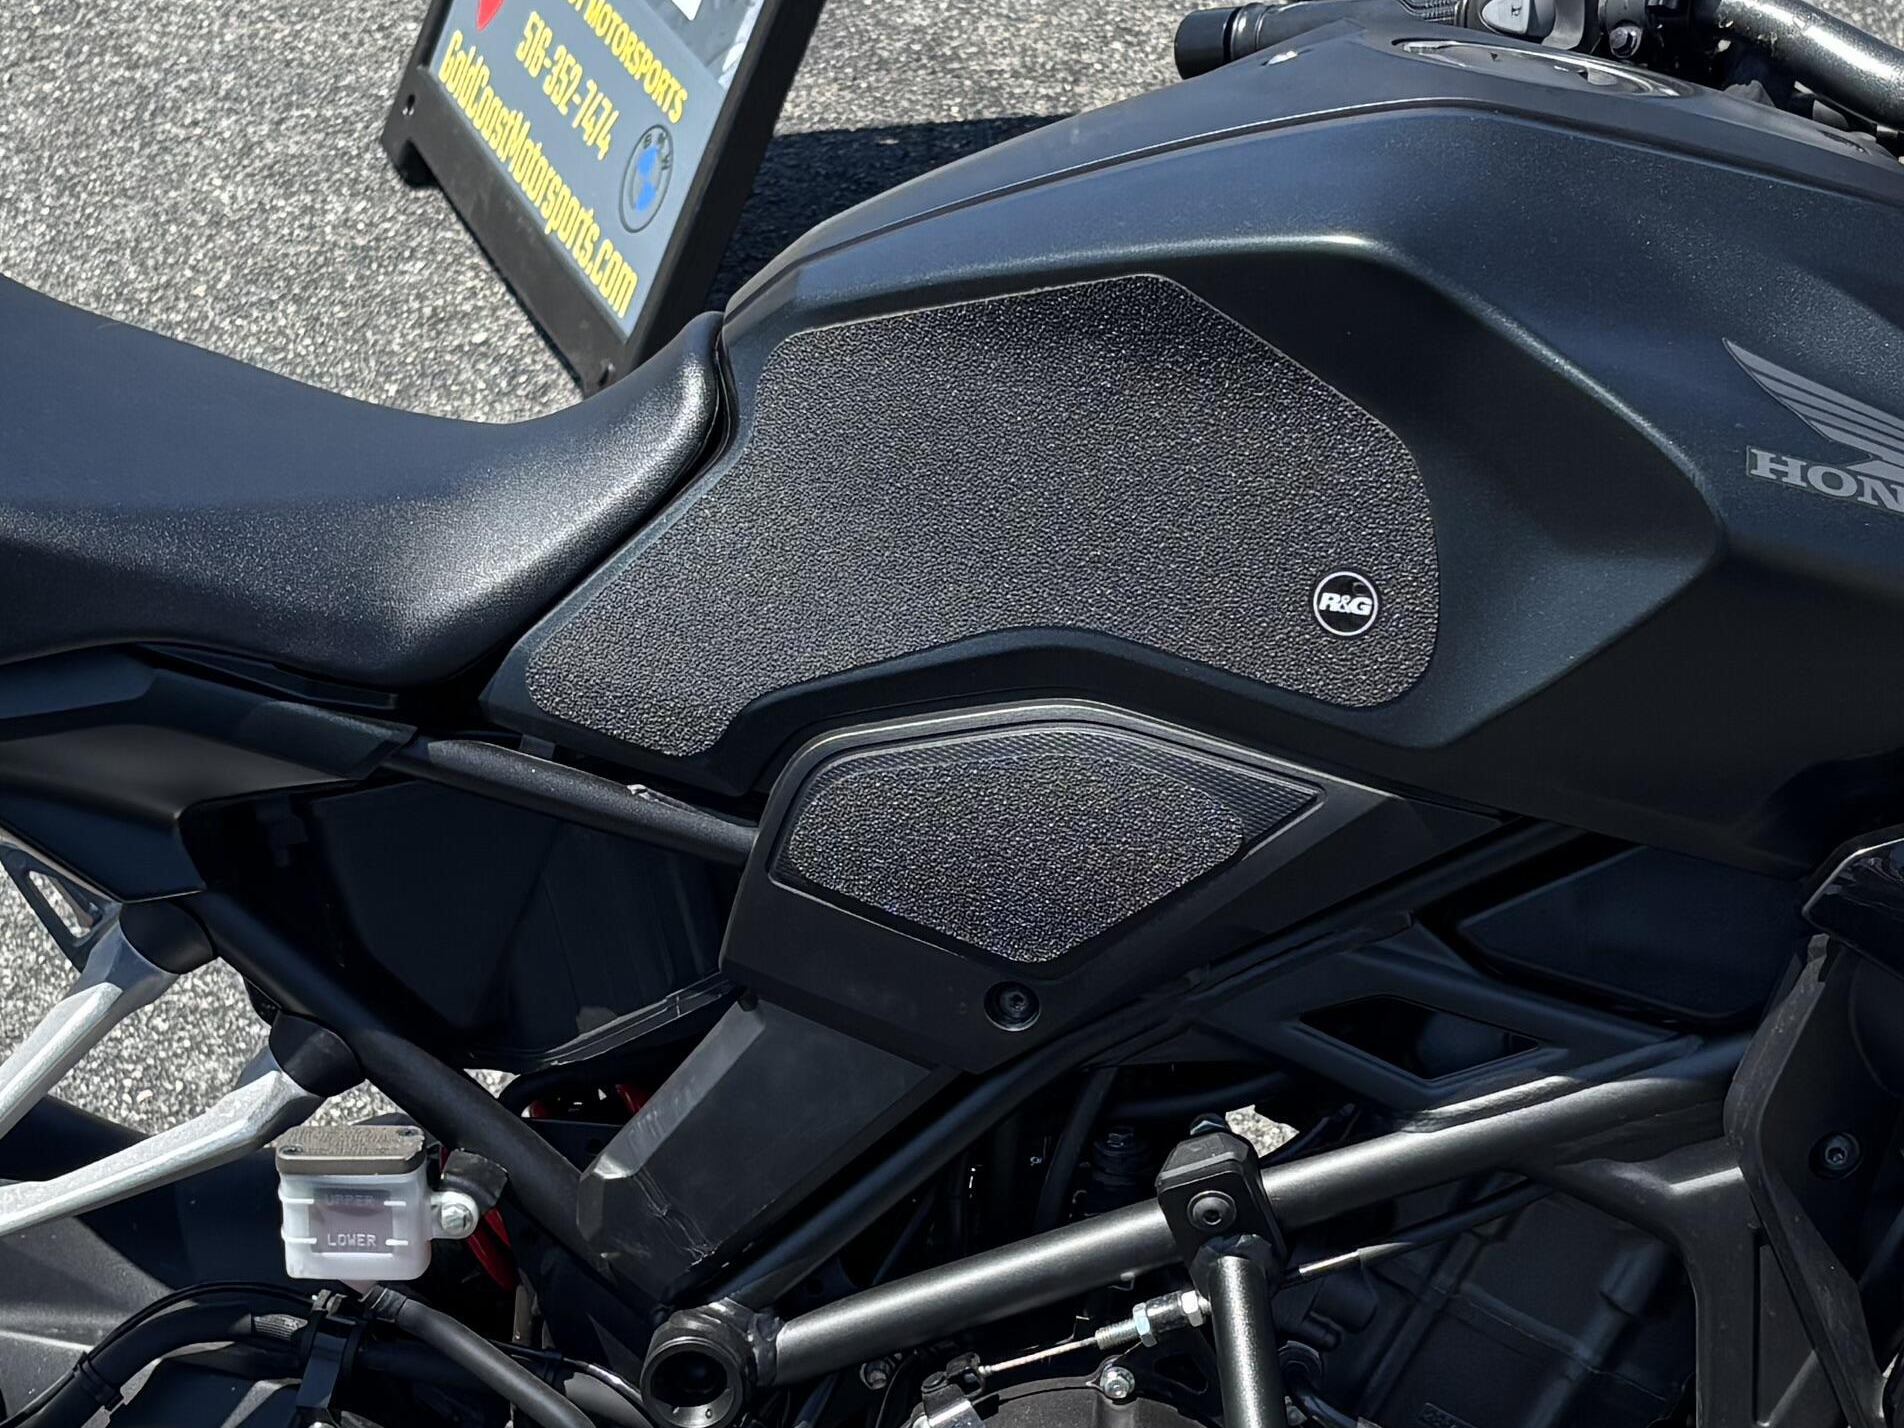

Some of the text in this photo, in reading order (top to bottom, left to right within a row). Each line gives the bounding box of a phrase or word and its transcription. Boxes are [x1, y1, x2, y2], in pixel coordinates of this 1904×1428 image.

[515, 10, 620, 161] 516-352-7474
[438, 29, 639, 319] GoldCoastMotorsports.com
[1318, 592, 1373, 617] R&G
[326, 1193, 376, 1207] UPPER
[326, 1232, 377, 1248] LOWER
